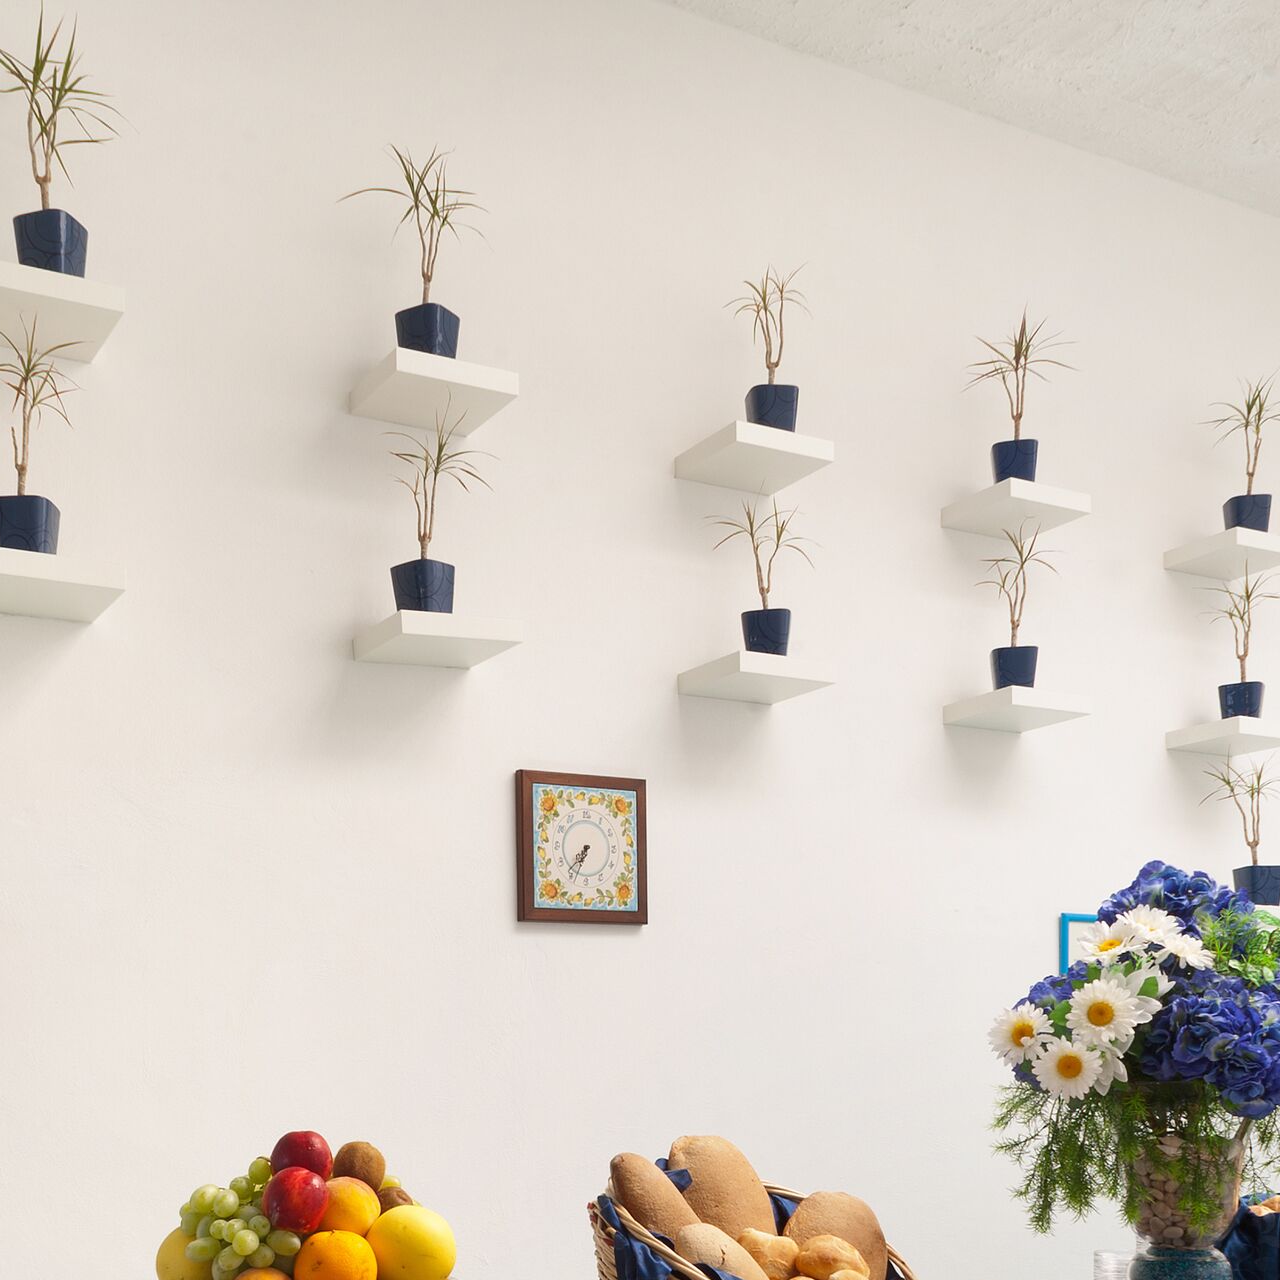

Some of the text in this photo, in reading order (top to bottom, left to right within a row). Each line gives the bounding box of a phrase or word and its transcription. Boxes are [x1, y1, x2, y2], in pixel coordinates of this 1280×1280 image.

[582, 810, 592, 819] 12
[554, 841, 560, 850] 9
[611, 845, 617, 854] 3
